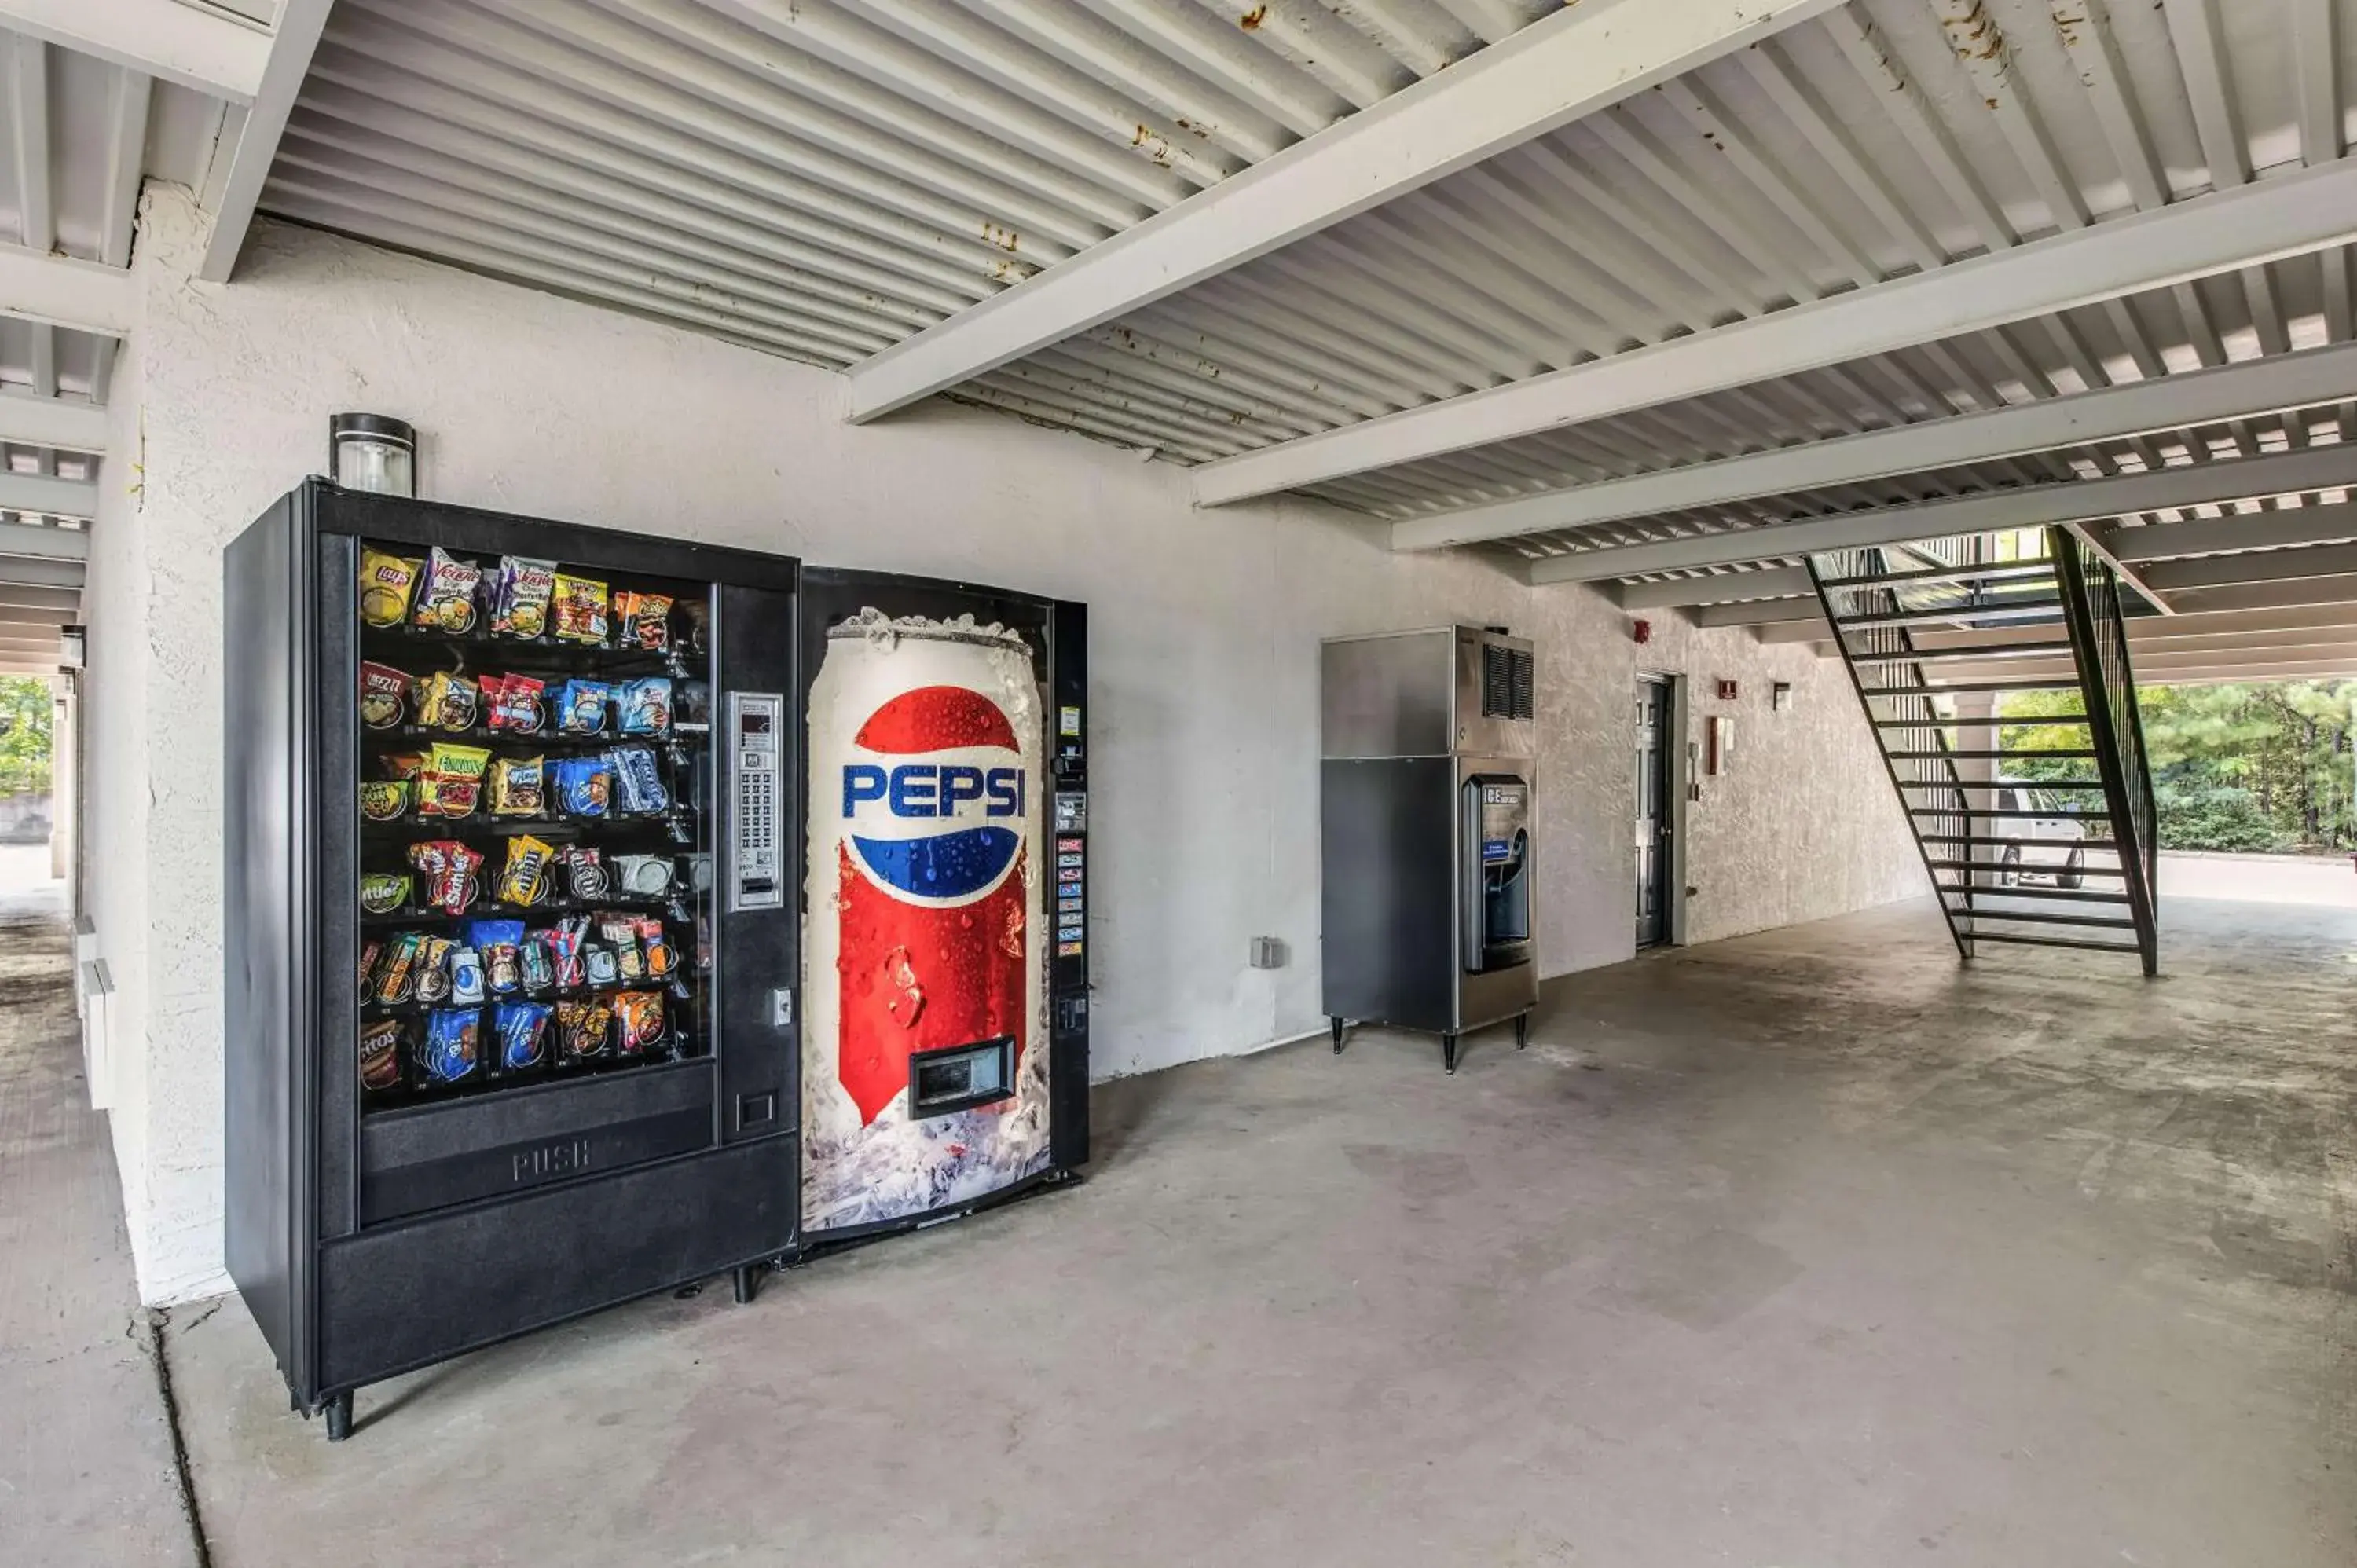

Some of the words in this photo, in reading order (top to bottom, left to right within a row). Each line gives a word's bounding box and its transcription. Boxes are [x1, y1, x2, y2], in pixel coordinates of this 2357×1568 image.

[842, 764, 1025, 818] PEPSI
[1483, 788, 1501, 804] ICE
[513, 1139, 589, 1181] PUSH
